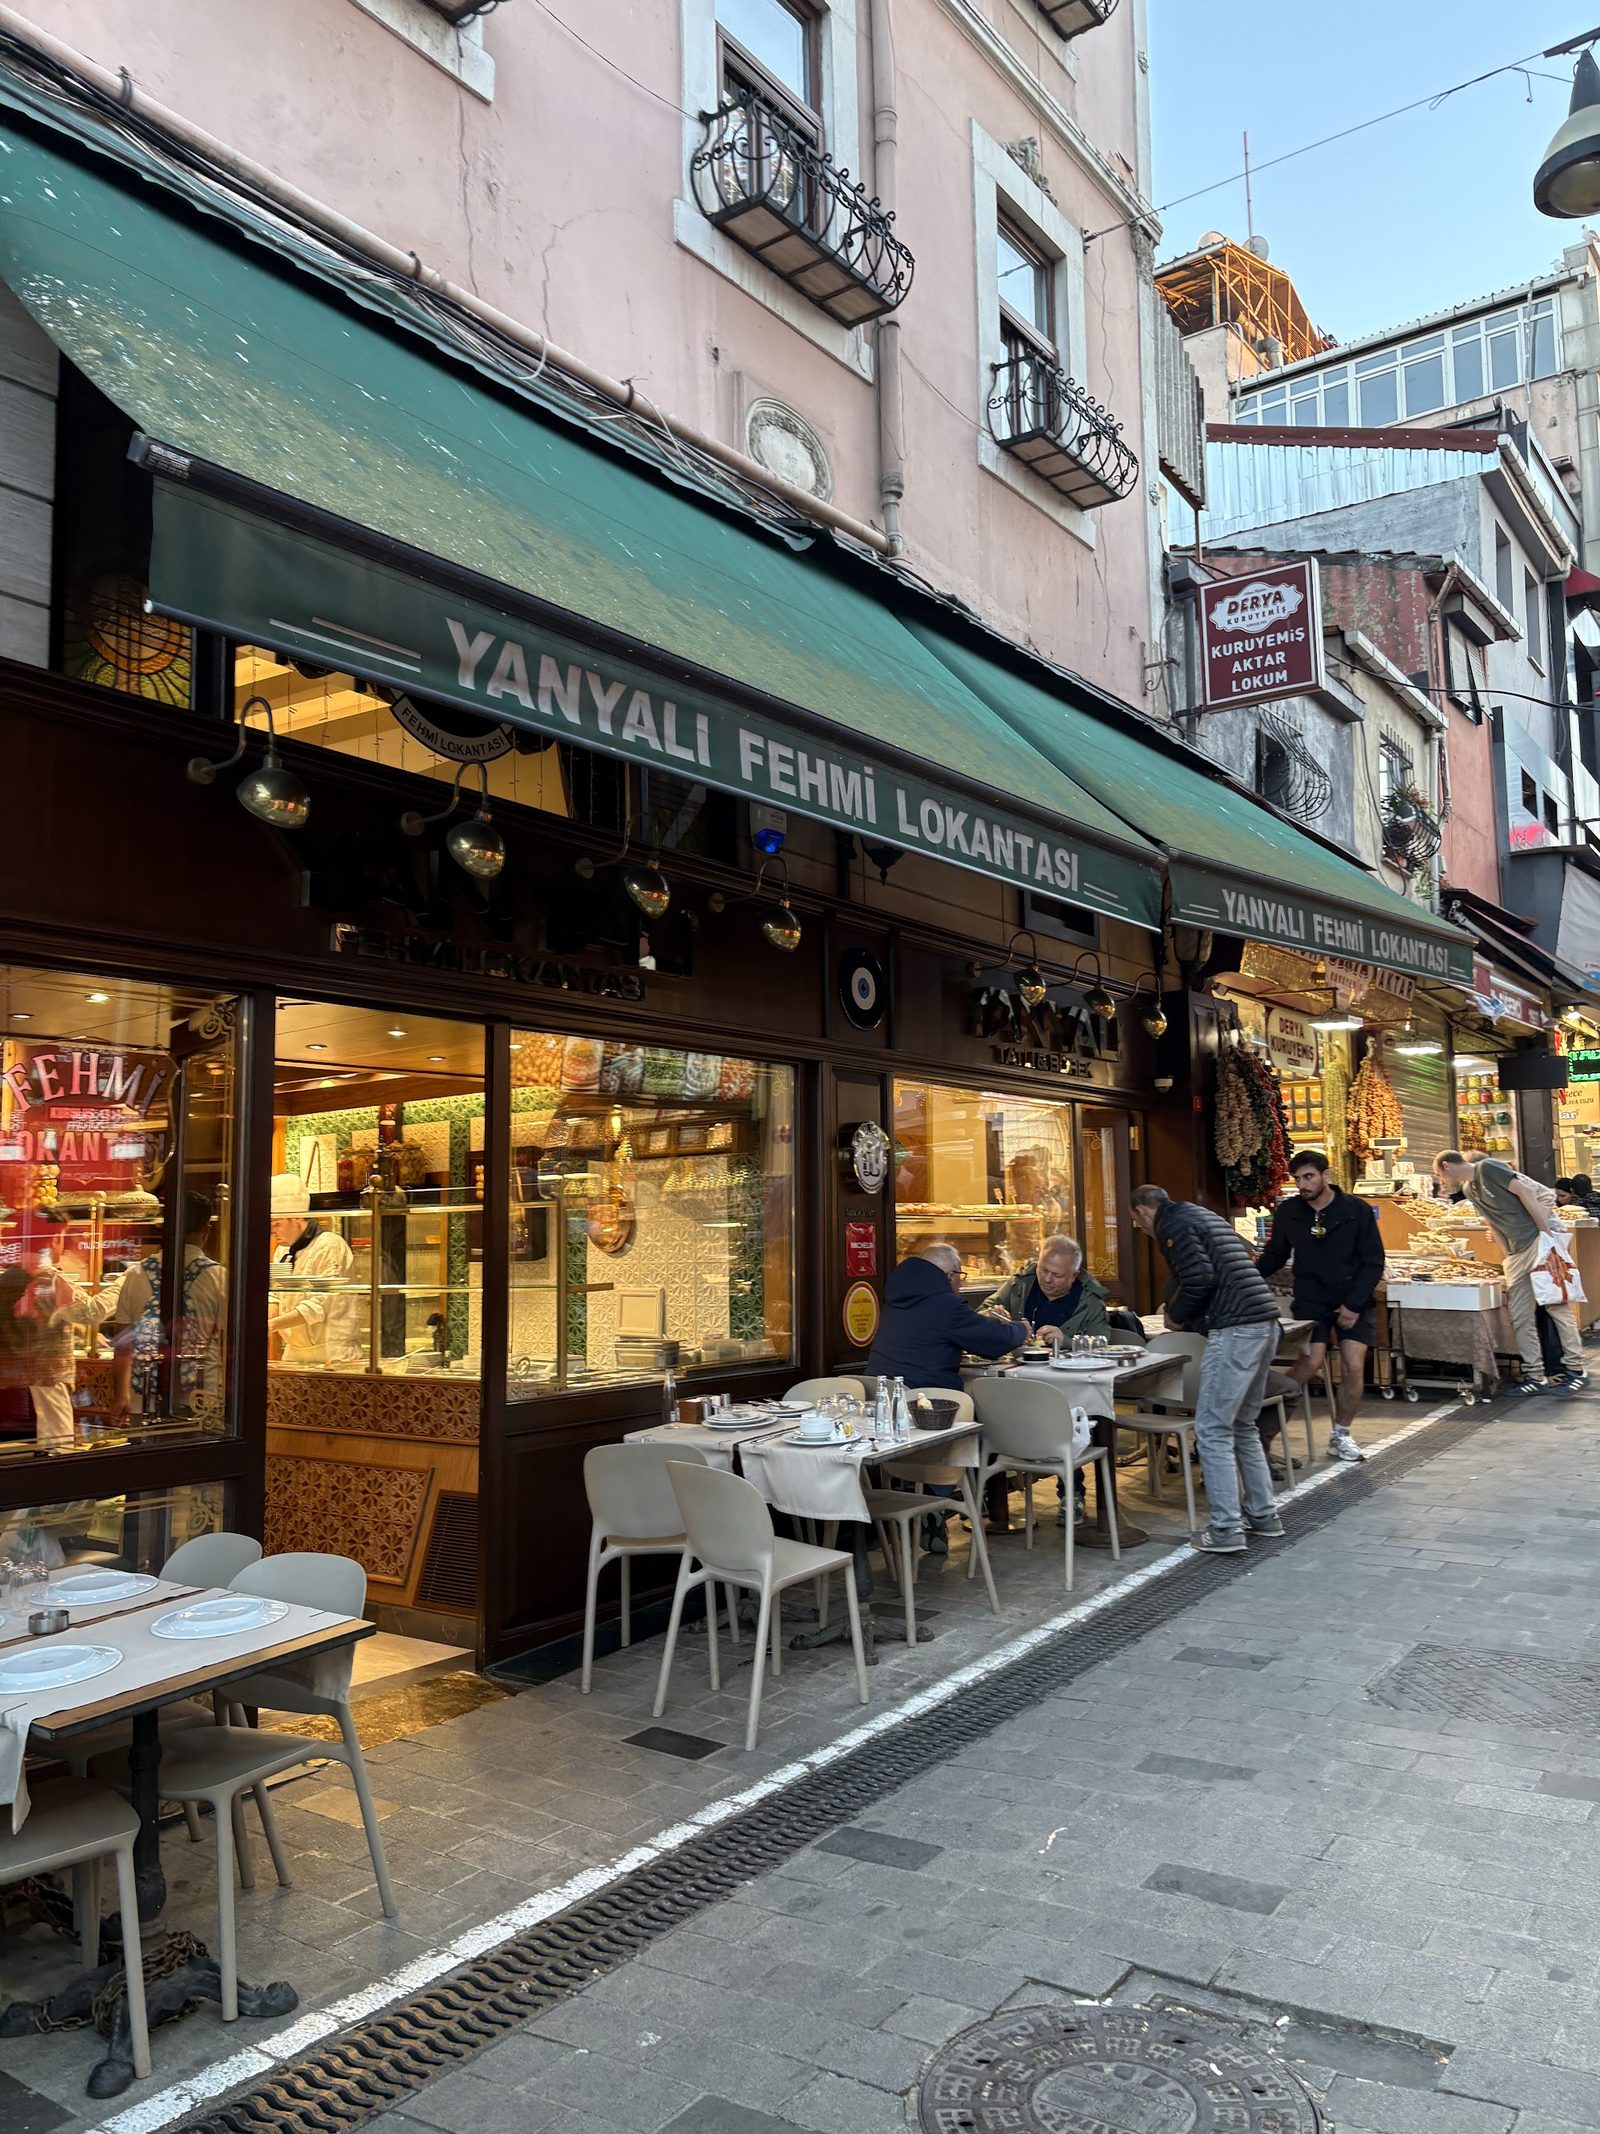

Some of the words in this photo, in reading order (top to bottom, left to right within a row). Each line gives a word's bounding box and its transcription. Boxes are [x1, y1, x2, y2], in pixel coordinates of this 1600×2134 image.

[1227, 591, 1285, 615] DERYA
[1231, 651, 1286, 674] AKTAR
[1231, 669, 1288, 693] LOKUM
[402, 707, 439, 745] FEHMİ
[440, 735, 505, 757] LOKANTASI
[445, 617, 712, 768] YANYALI
[738, 727, 877, 825] FEHMİ
[895, 788, 1079, 892] LOKANTASI
[1222, 889, 1305, 939] YANYALI
[1313, 913, 1364, 953] FEHMİ
[1371, 929, 1448, 973] LOKANTASI
[1279, 1016, 1305, 1039] DERYA
